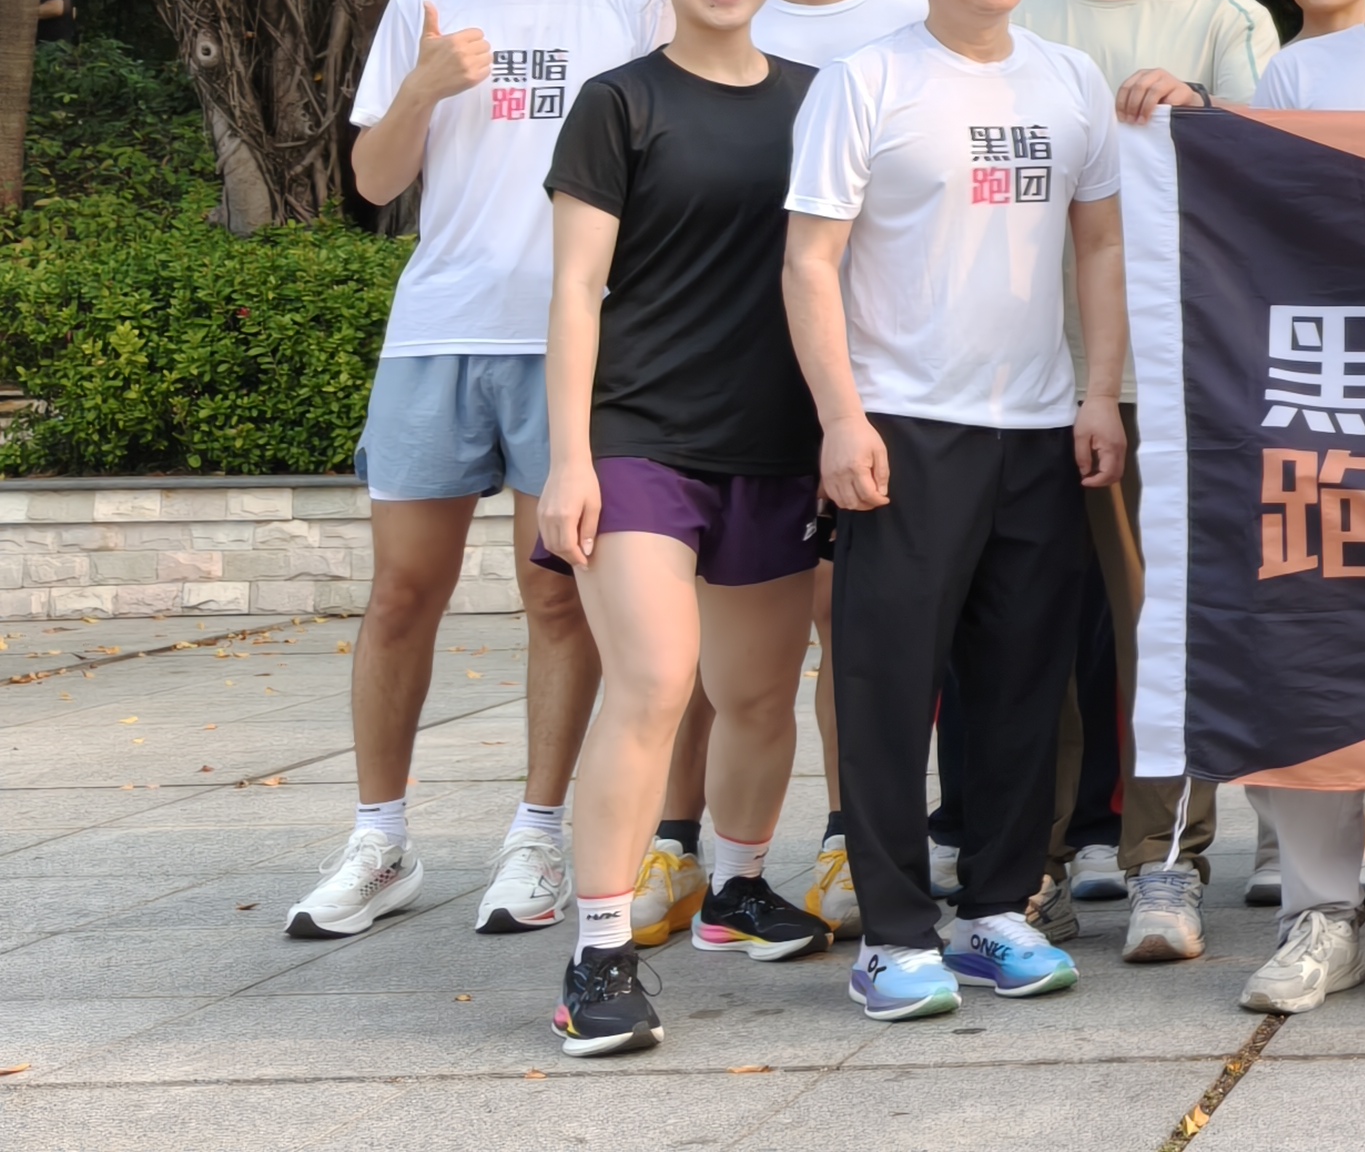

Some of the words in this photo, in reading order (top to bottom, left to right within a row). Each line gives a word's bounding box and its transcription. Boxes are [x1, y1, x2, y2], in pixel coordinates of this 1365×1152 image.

[491, 48, 569, 83] 黑暗
[491, 86, 565, 121] 跑团
[968, 124, 1052, 162] 黑暗
[971, 166, 1053, 204] 跑团
